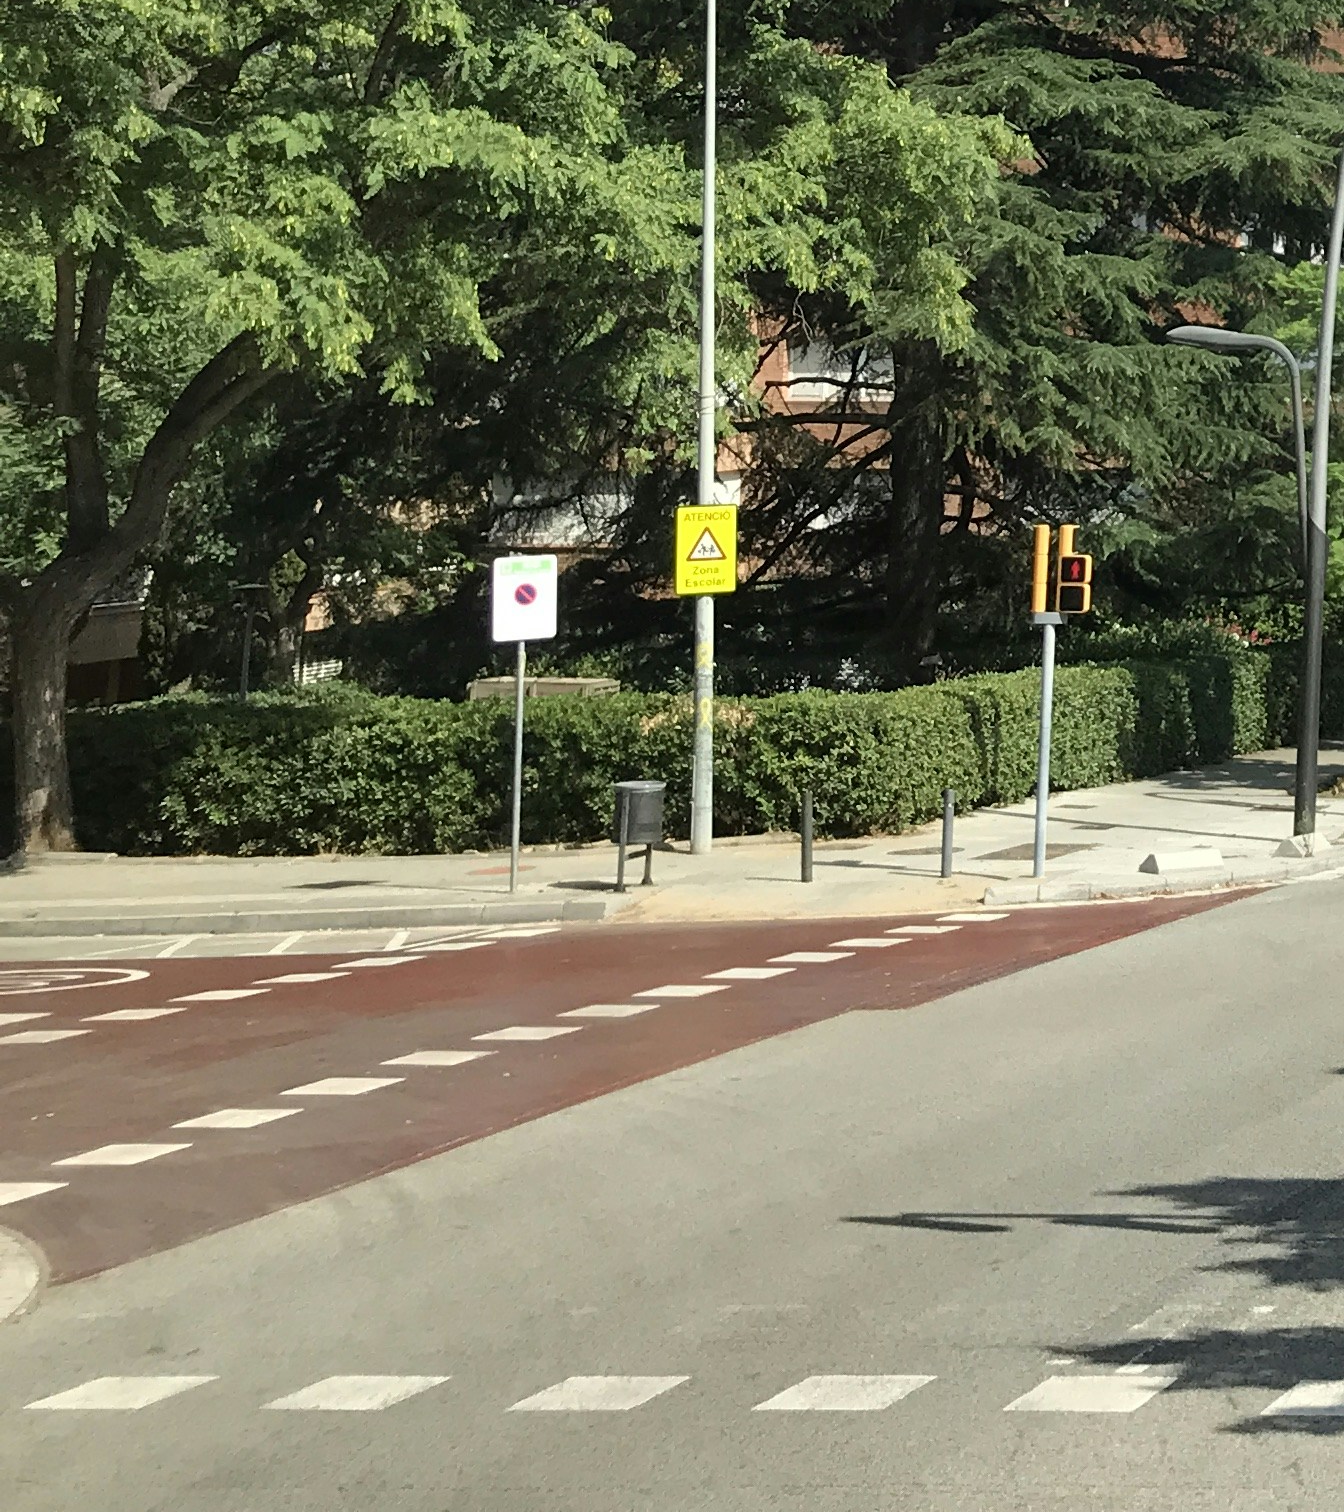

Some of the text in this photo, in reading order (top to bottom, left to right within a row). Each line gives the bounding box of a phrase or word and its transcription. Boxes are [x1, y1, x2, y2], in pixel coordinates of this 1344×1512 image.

[684, 510, 731, 522] ATENCIÓ
[693, 566, 720, 575] Zona
[685, 578, 726, 587] Escolar
